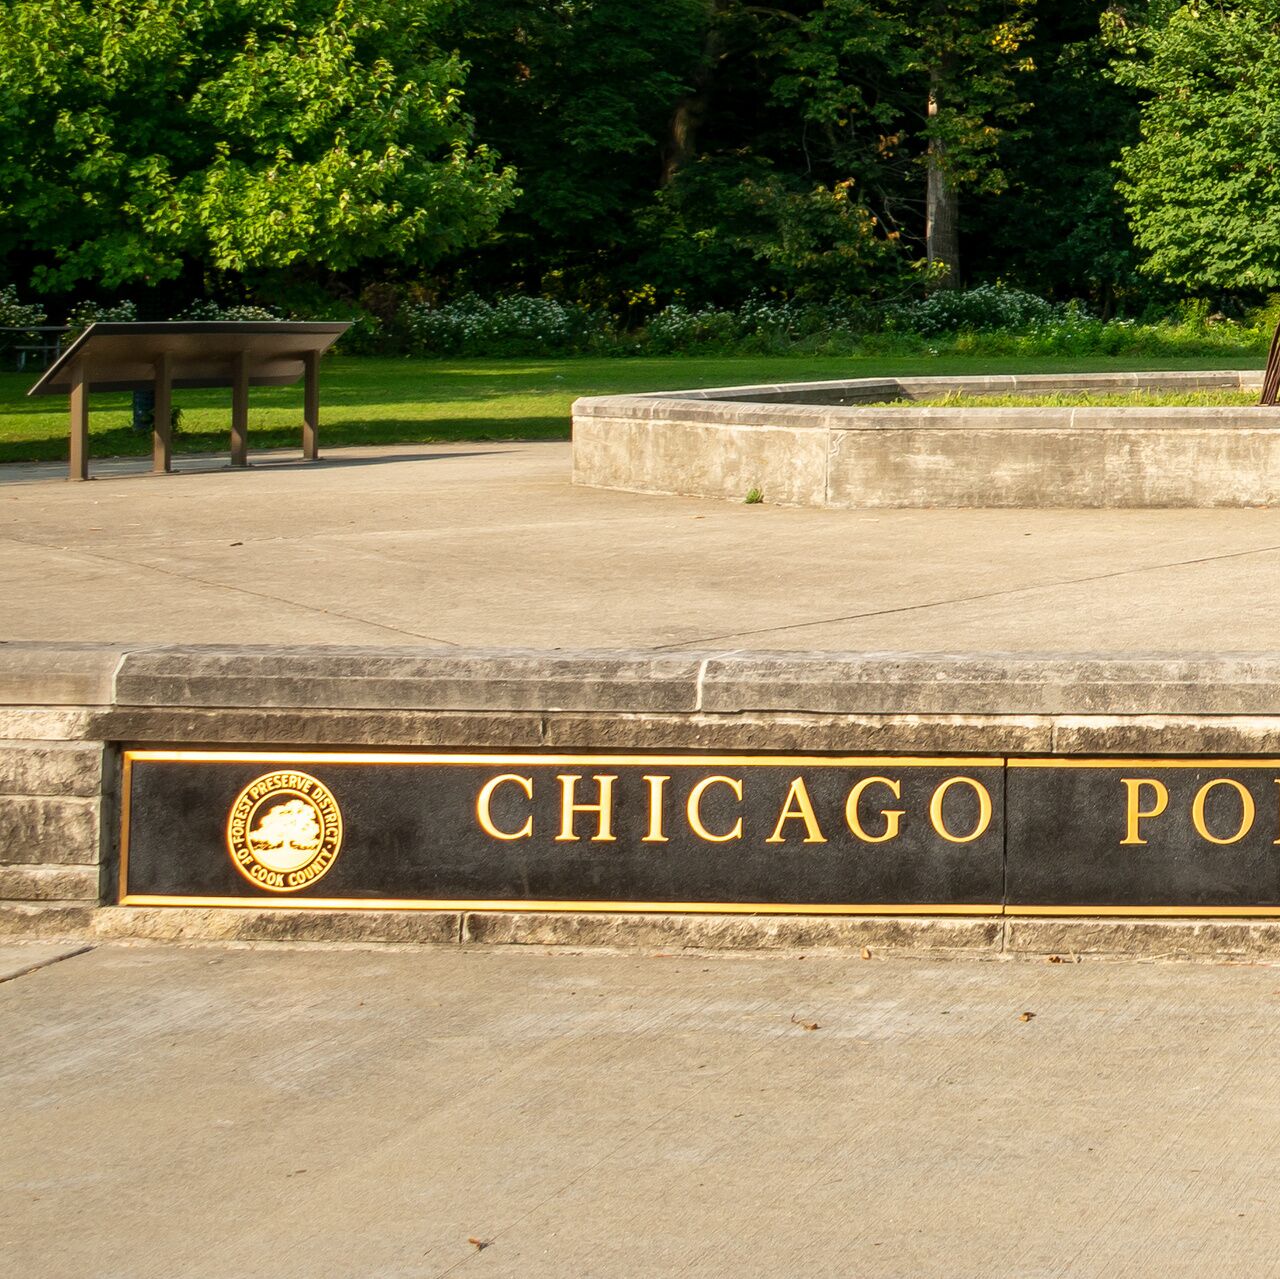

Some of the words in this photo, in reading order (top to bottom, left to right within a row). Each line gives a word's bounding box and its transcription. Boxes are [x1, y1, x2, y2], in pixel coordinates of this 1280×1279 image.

[232, 796, 254, 844] FOREST
[250, 775, 313, 799] PRESERVE
[313, 788, 338, 845] DISTRICT
[476, 773, 992, 843] CHICAGO
[237, 849, 252, 865] OF
[251, 864, 284, 887] COOK
[288, 849, 332, 886] COUNTY
